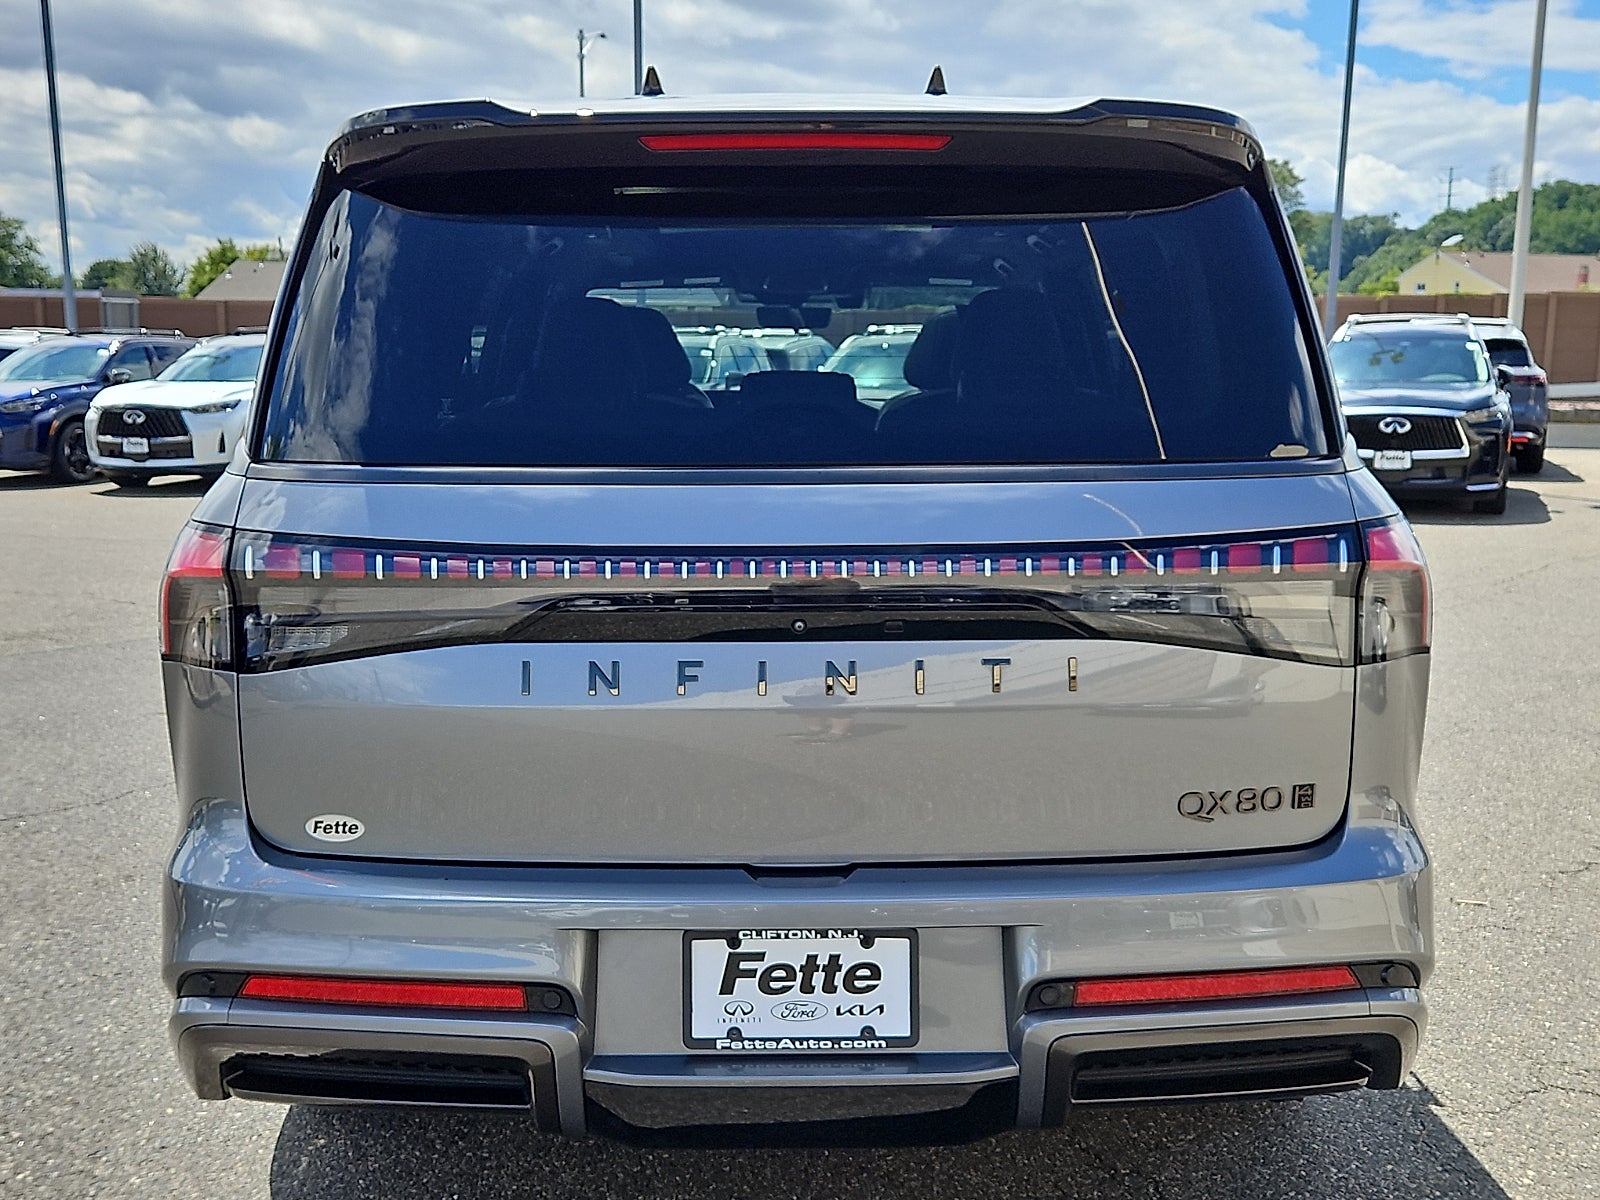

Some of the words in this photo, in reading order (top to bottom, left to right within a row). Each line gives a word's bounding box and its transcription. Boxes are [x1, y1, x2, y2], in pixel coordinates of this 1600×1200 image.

[521, 657, 1077, 697] INFINITI
[1177, 786, 1284, 823] QX80
[312, 820, 359, 835] Fette
[738, 929, 821, 940] CLIFTON,
[828, 929, 864, 940] N.J.
[718, 950, 883, 996] Fette
[780, 1001, 818, 1019] Ford
[717, 1016, 762, 1024] INFINITI
[716, 1038, 887, 1050] FetteAuto.com
